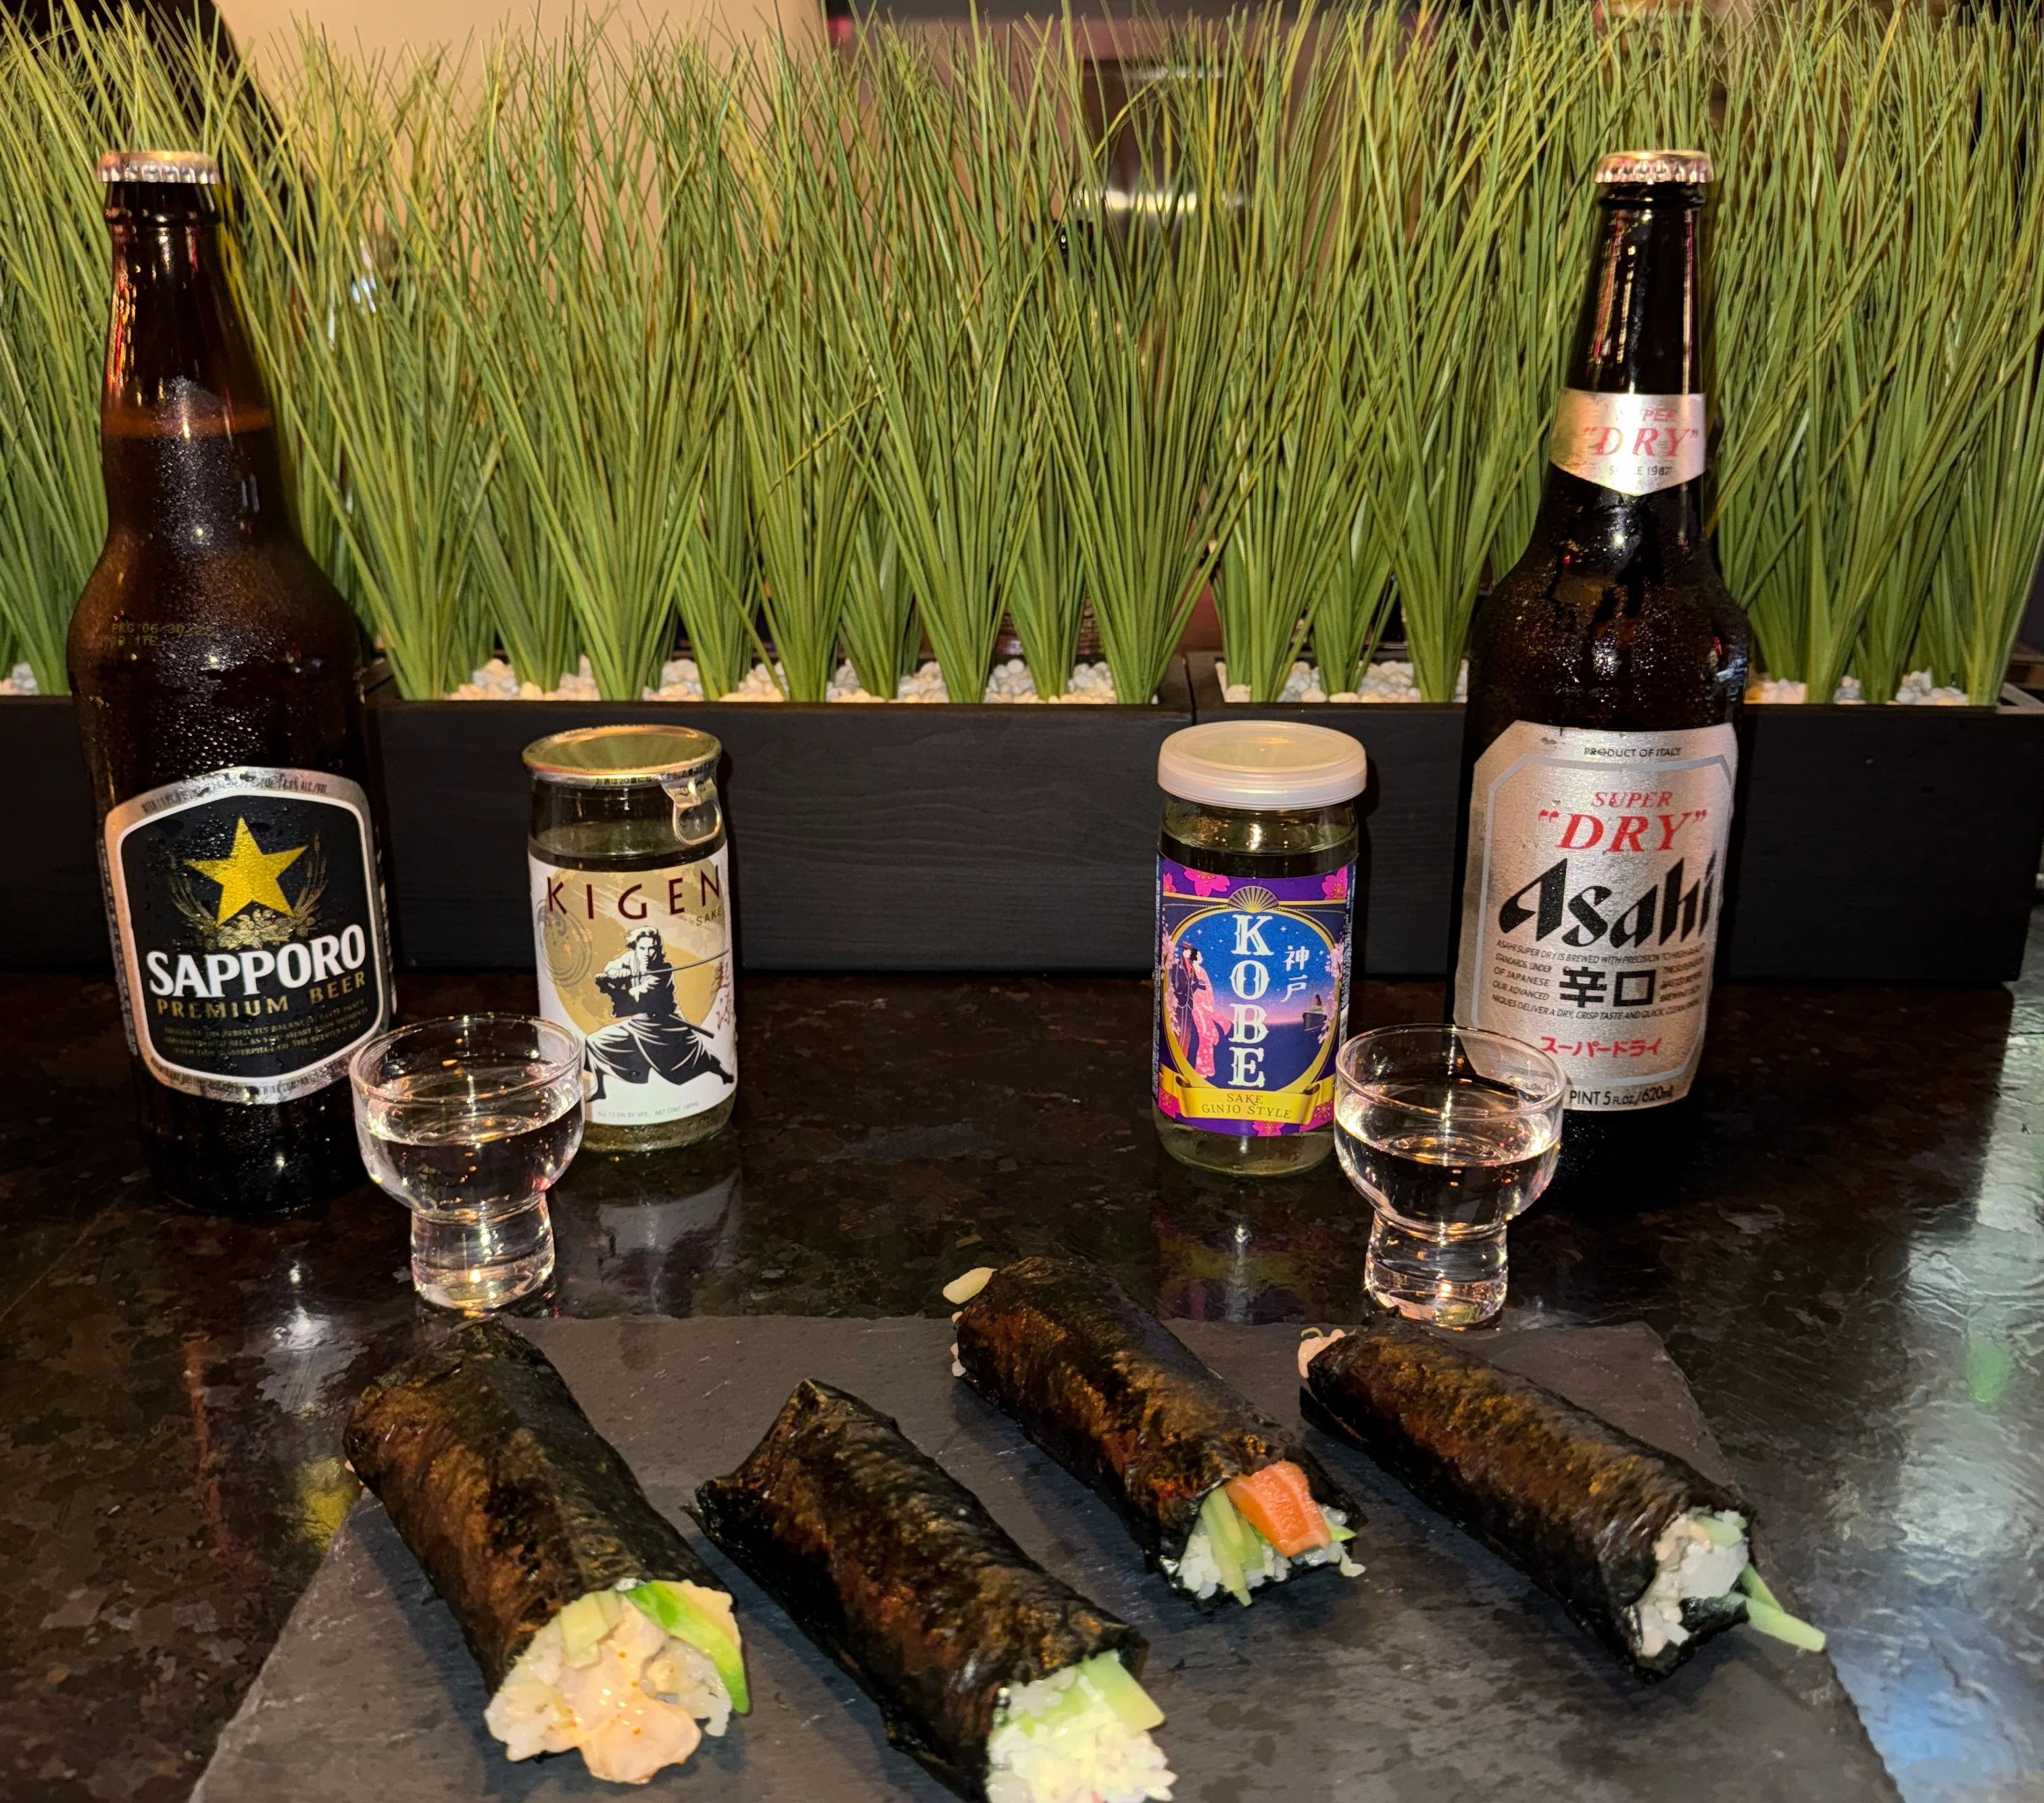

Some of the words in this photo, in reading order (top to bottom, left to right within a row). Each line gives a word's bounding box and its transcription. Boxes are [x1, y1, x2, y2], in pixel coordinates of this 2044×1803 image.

[1647, 466, 1672, 476] 1987
[1584, 747, 1636, 758] PRODUCT
[1638, 748, 1654, 758] OF
[1656, 747, 1682, 757] ITALY
[1591, 790, 1674, 808] SUPER
[1537, 809, 1707, 853] "DRY"
[546, 864, 721, 920] KIGEN
[1498, 847, 1718, 949] Asahi
[696, 905, 723, 927] SAKE
[146, 923, 366, 998] SAPPORO
[1496, 939, 1515, 954] ASAHI
[1515, 945, 1540, 957] SUPER
[1540, 950, 1557, 960] DRY
[1557, 952, 1565, 961] IS
[1565, 954, 1599, 964] BREWED
[1601, 956, 1621, 964] WITH
[1622, 954, 1660, 964] PRECISION
[1280, 945, 1311, 1004] 神戸
[1493, 966, 1505, 976] OF
[1506, 970, 1551, 987] JAPANESE
[1529, 962, 1553, 973] UNDER
[155, 995, 289, 1020] PREMIUM
[308, 970, 366, 1006] BEER
[1492, 980, 1507, 991] OUR
[1509, 985, 1550, 1001] ADVANCED
[1559, 966, 1657, 1008] 辛口
[1227, 914, 1275, 1088] KOBE
[1517, 1002, 1551, 1014] DELIVER
[1576, 1011, 1599, 1020] CRISP
[1599, 1012, 1622, 1020] TASTE
[1624, 1010, 1641, 1019] AND
[1540, 1035, 1662, 1058] スーパードライ
[1225, 1093, 1264, 1106] SAKE
[1569, 1089, 1601, 1106] PINT
[1603, 1091, 1612, 1106] 5
[1201, 1104, 1242, 1114] GINJO
[1246, 1105, 1292, 1119] STYLE
